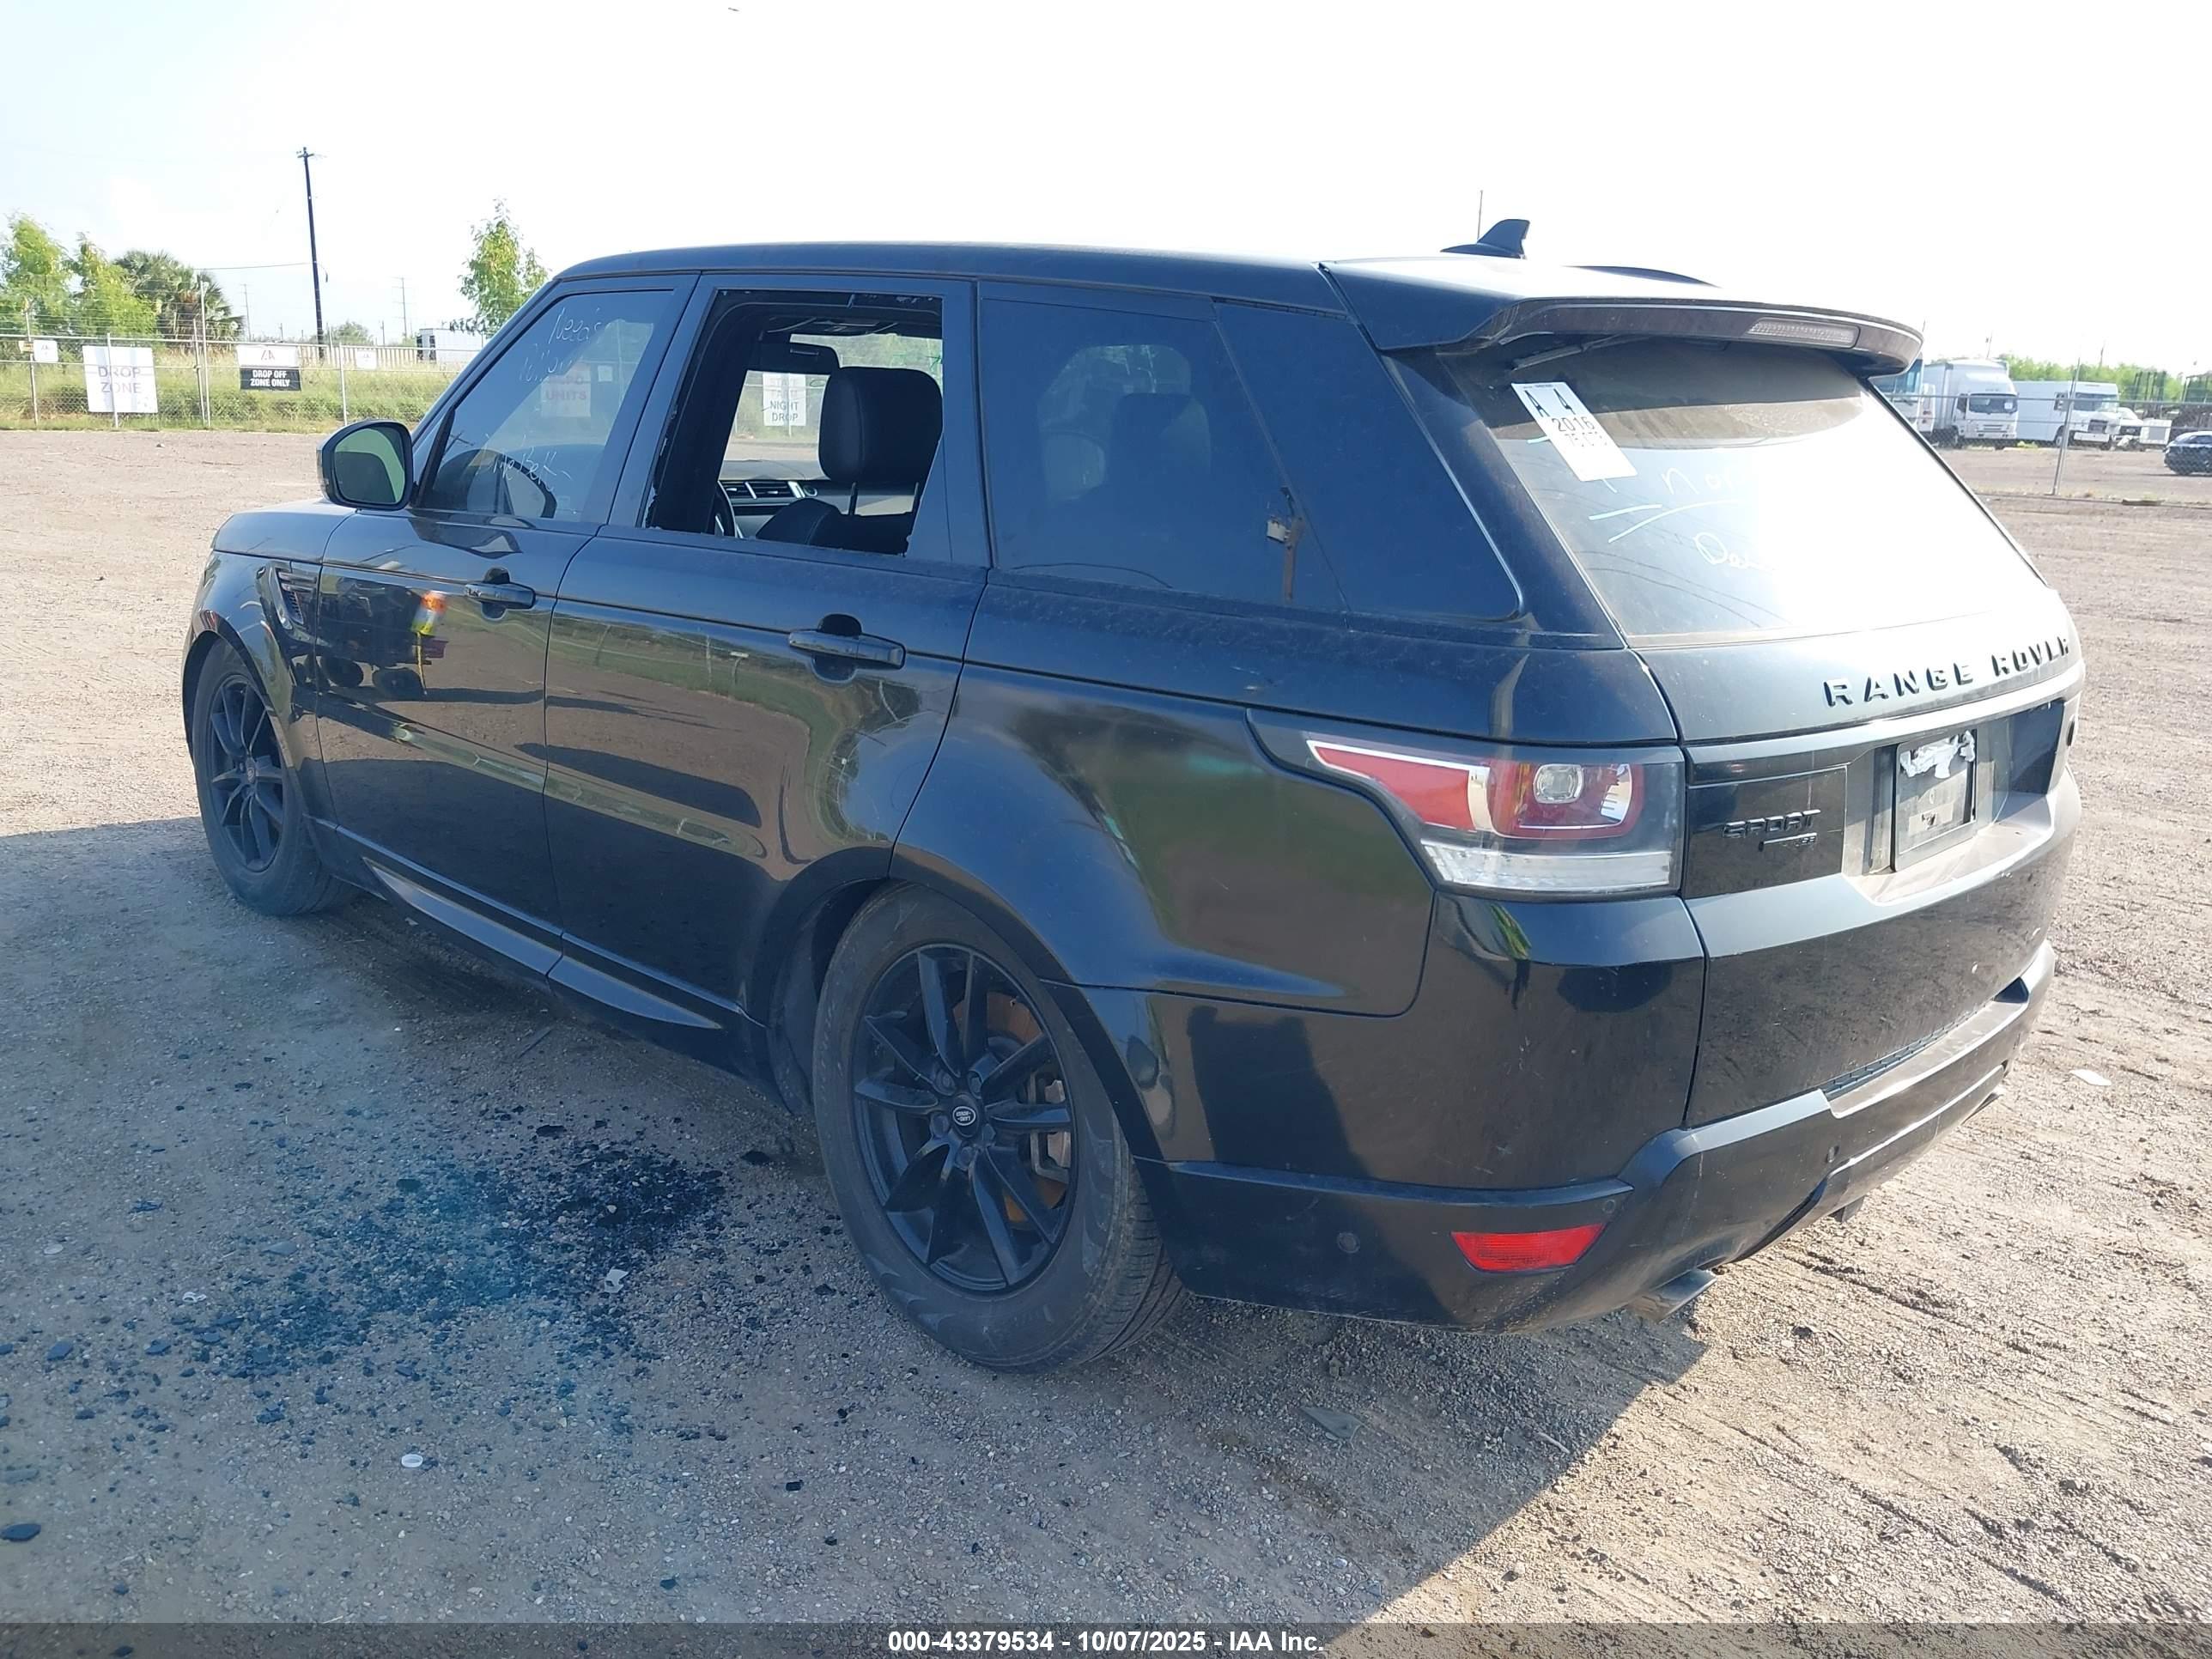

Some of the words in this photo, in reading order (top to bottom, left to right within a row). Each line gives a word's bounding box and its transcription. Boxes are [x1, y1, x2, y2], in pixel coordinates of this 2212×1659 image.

[97, 366, 141, 379] DROP
[100, 382, 142, 393] ZONE
[271, 379, 290, 387] ONLY
[545, 390, 587, 401] UNITS
[770, 399, 798, 411] NIGHT
[772, 412, 799, 422] DROP
[1551, 416, 1595, 432] 2016
[1823, 662, 1974, 708] RANGE
[1722, 810, 1821, 839] SPORT
